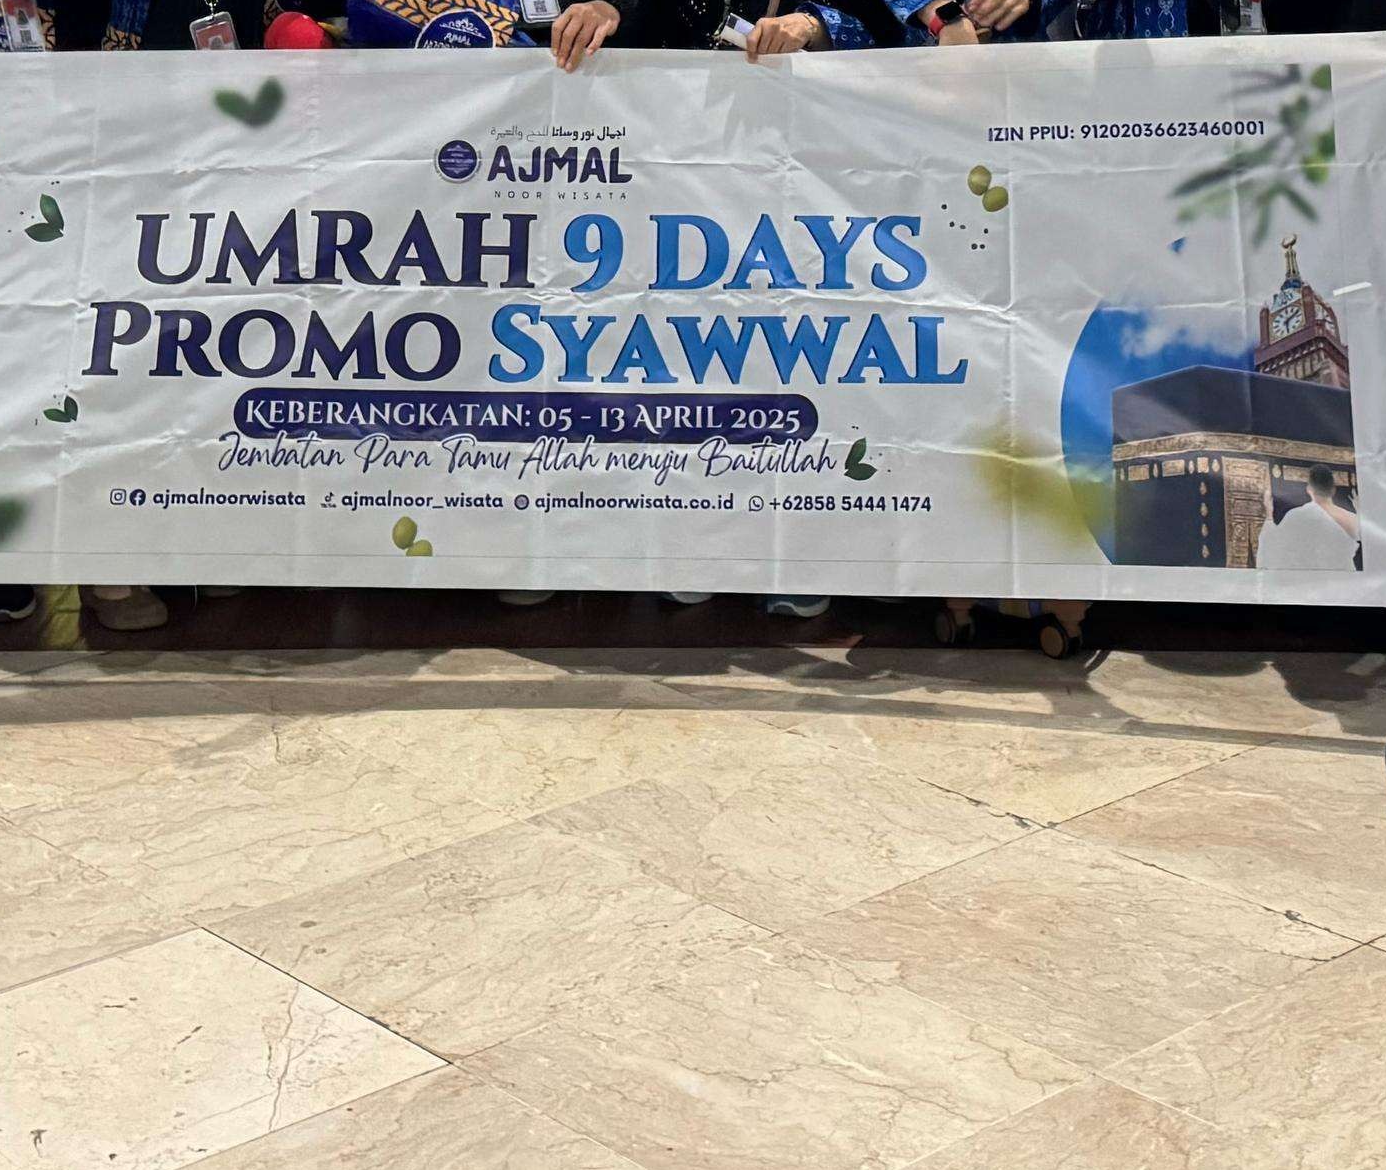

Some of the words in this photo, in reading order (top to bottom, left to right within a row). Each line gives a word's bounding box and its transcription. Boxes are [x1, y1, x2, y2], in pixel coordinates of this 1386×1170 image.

[988, 126, 1024, 142] IZIN
[1030, 124, 1075, 140] PPIU:
[1080, 120, 1265, 139] 91202036623460001
[488, 145, 633, 183] AJMAL
[493, 190, 544, 200] NOOR
[557, 190, 629, 201] WISATA
[136, 211, 535, 290] UMRAH
[564, 212, 625, 293] 9
[648, 211, 928, 292] DAYS
[81, 299, 463, 382] PROMO
[487, 302, 970, 386] SYAWWAL
[245, 399, 531, 429] KEBERANGKATAN:
[538, 407, 573, 432] 05
[600, 407, 626, 433] 13
[633, 404, 723, 435] APRIL
[731, 408, 801, 434] 2025
[217, 431, 346, 473] Jembatan
[354, 433, 433, 475] Para
[441, 433, 512, 475] Tamu
[517, 435, 600, 481] Allah
[697, 435, 838, 478] Baitullah
[152, 486, 306, 511] ajmalnoorwisata
[341, 490, 503, 512] ajmalnoor_wisata
[534, 491, 734, 513] ajmalnoorwisata.co.id
[769, 494, 836, 511] +62858
[841, 495, 886, 512] 5444
[891, 495, 932, 512] 1474
